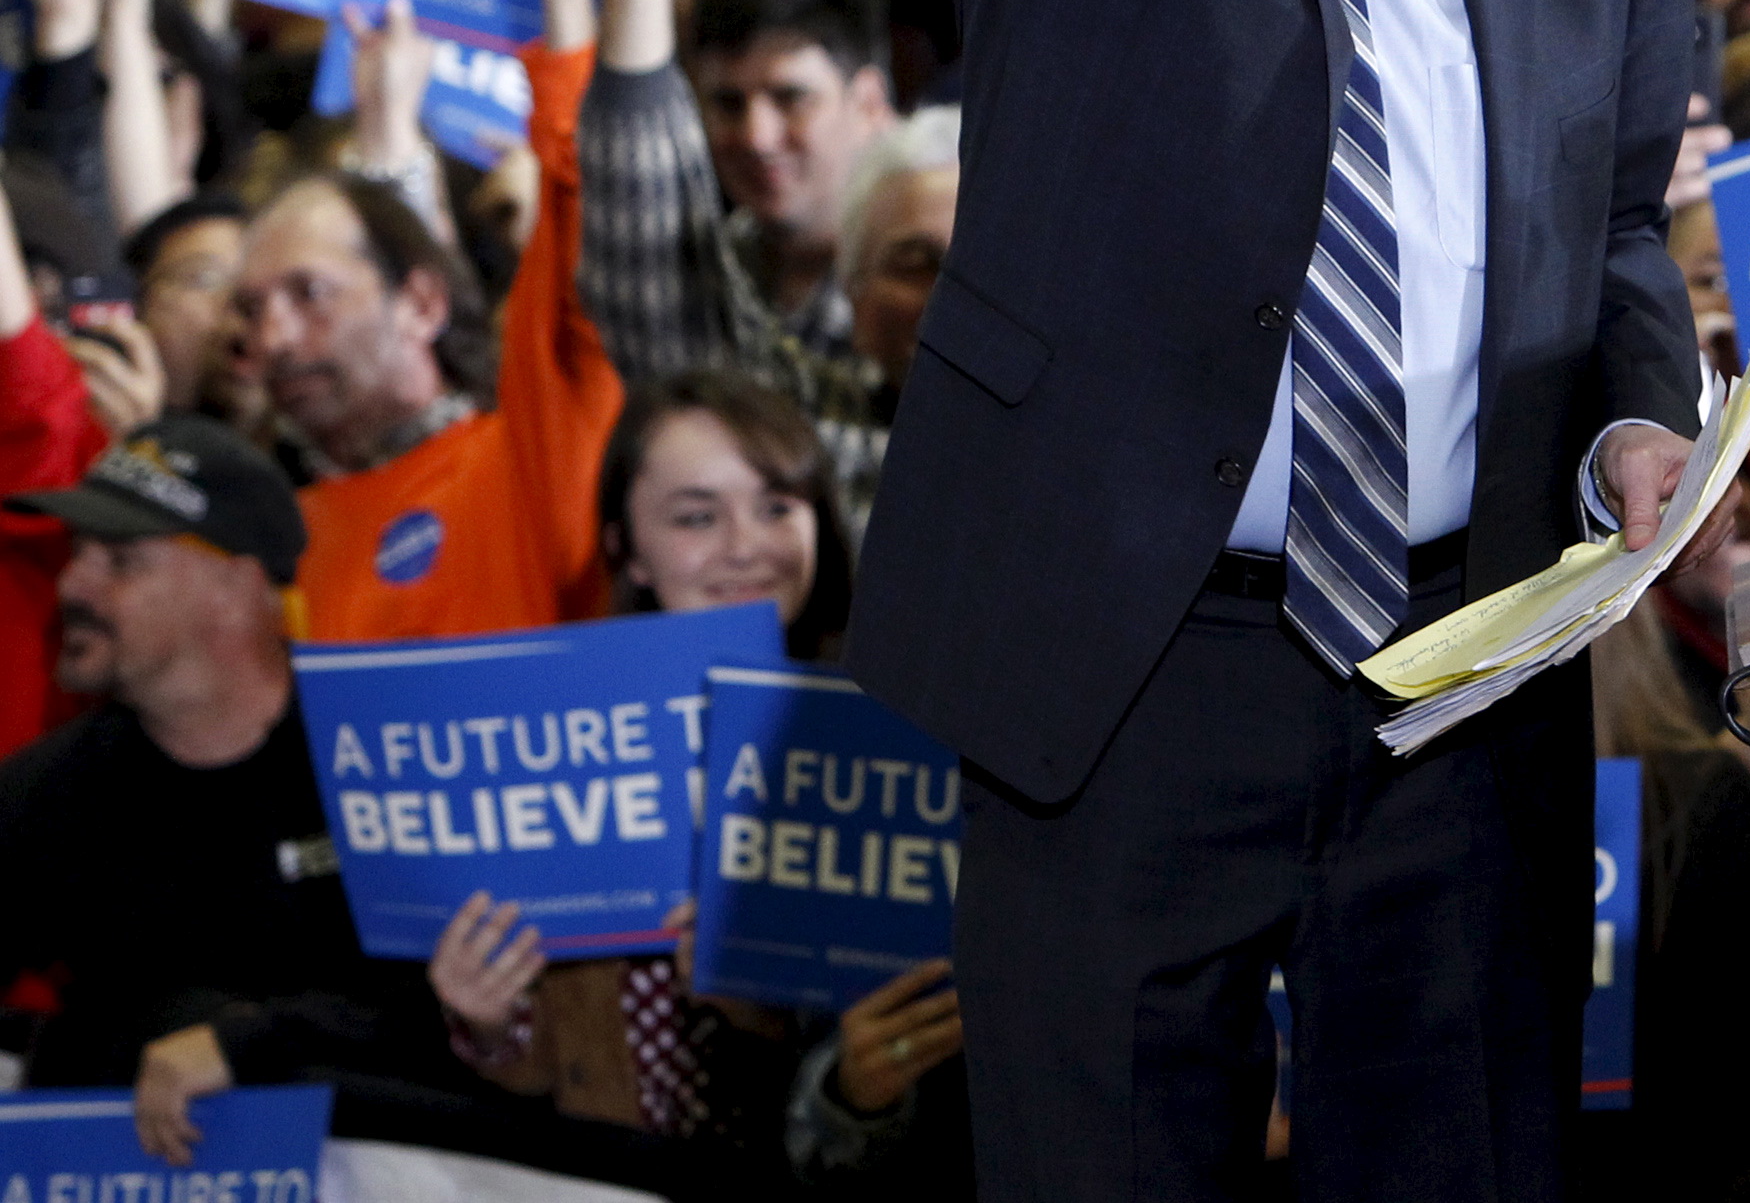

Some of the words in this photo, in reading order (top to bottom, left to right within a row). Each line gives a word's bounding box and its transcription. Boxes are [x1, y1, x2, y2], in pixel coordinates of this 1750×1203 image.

[331, 722, 377, 780] A
[380, 701, 656, 780] FUTURE
[664, 693, 712, 756] T
[336, 771, 670, 857] BELIEVE
[722, 741, 770, 805] A
[781, 748, 962, 826] FUTU
[716, 813, 962, 906] BELIE
